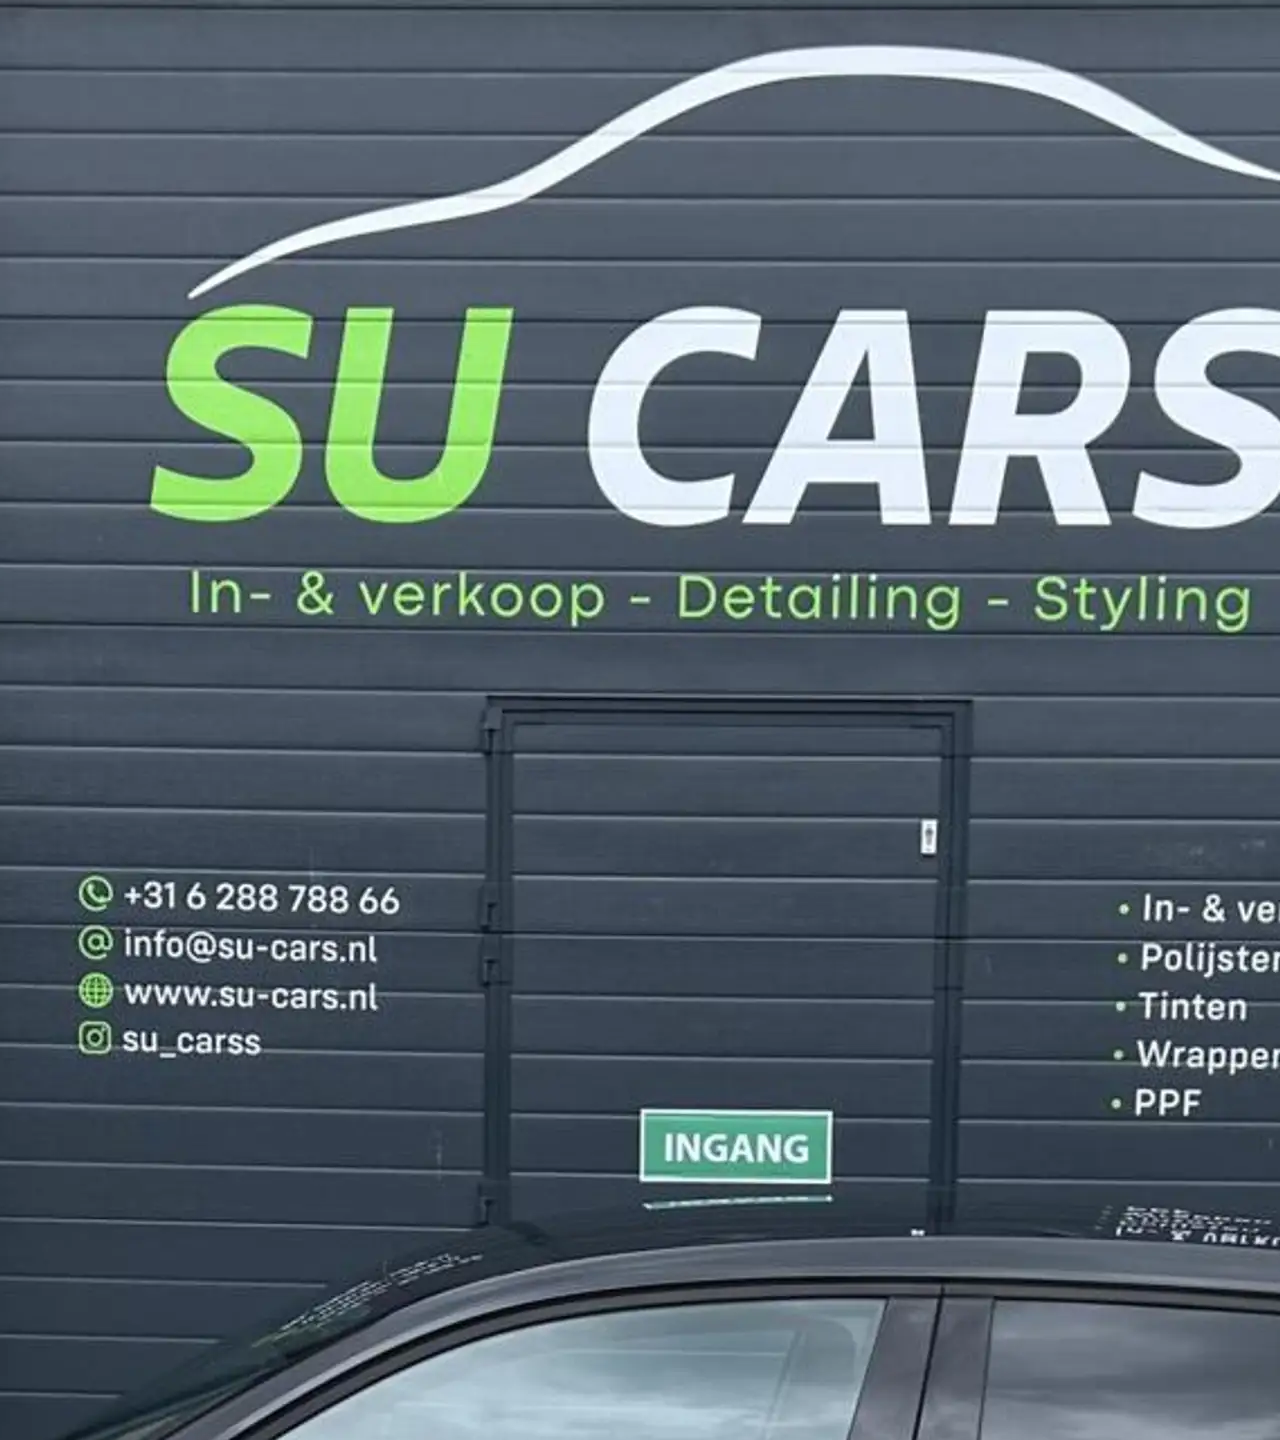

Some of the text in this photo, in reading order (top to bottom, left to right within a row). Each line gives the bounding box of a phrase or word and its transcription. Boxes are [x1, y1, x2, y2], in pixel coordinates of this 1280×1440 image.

[150, 304, 514, 523] SU
[192, 569, 271, 613] In-
[297, 569, 334, 615] &
[359, 571, 604, 627] verkoop
[679, 573, 959, 631] Detailing
[1035, 575, 1250, 632] Styling
[123, 880, 400, 915] +31 6 288 788 66
[1143, 893, 1191, 922] In-
[1202, 893, 1227, 923] &
[125, 929, 378, 964] info@su-cars.nl
[124, 982, 378, 1011] www.su-cars.nl
[1138, 991, 1247, 1021] Tinten
[122, 1030, 262, 1059] su_carss
[1135, 1087, 1202, 1117] PPF
[664, 1132, 809, 1164] INGANG
